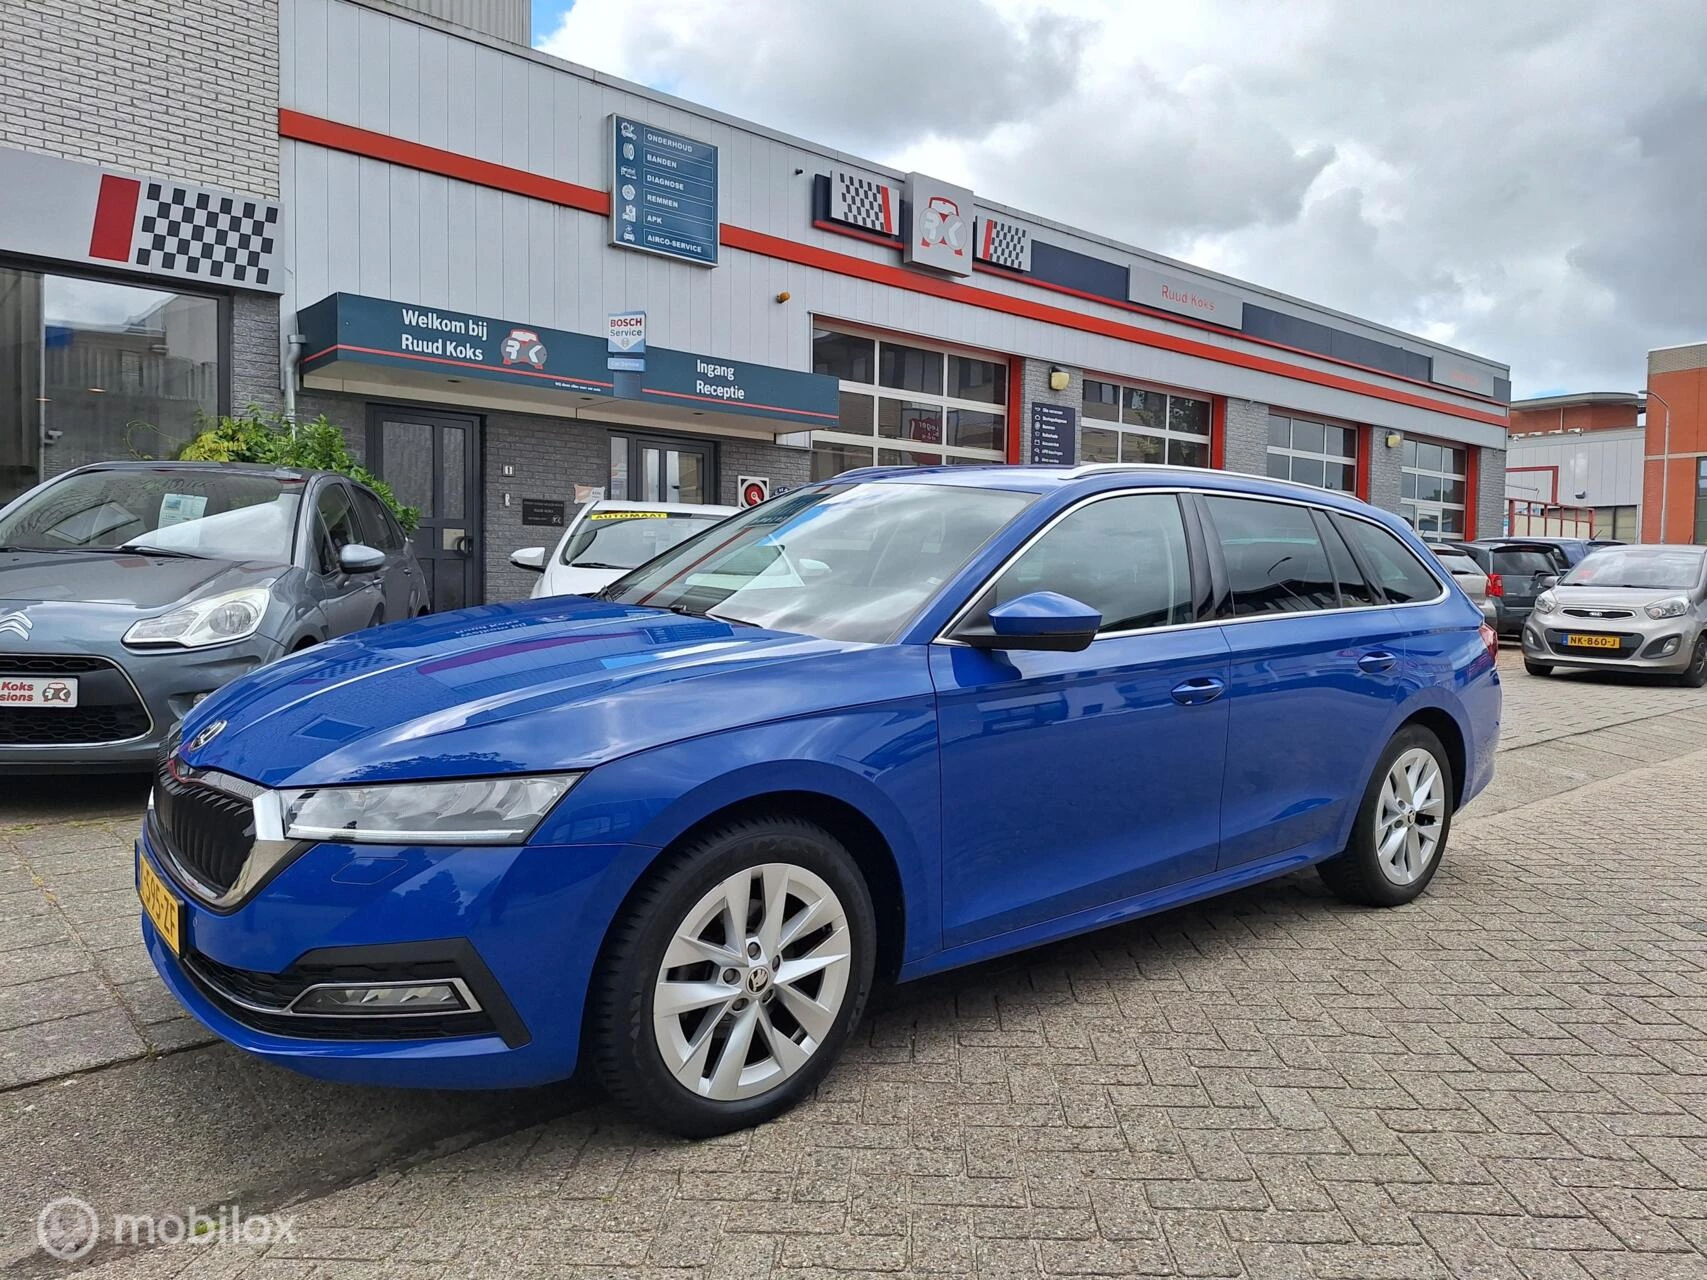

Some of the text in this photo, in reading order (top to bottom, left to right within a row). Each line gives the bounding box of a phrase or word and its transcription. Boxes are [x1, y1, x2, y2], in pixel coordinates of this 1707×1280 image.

[647, 134, 693, 153] ONDERHOUD
[647, 154, 677, 168] BANDEN
[647, 174, 684, 191] DIAGNOSE
[647, 194, 679, 209] REMMEN
[647, 215, 663, 225] APK
[647, 235, 702, 253] AIRCO-SERVICE
[1161, 284, 1217, 311] Ruud Koks
[402, 308, 488, 341] Welkom bij
[610, 317, 642, 327] BOSCH
[610, 328, 642, 337] Service
[401, 333, 484, 361] Ruud Koks
[697, 359, 735, 381] Ingang
[696, 379, 745, 400] Receptie
[596, 512, 666, 520] AUTOMAAT
[1570, 636, 1616, 647] NK-860-J
[1, 681, 34, 691] Koks
